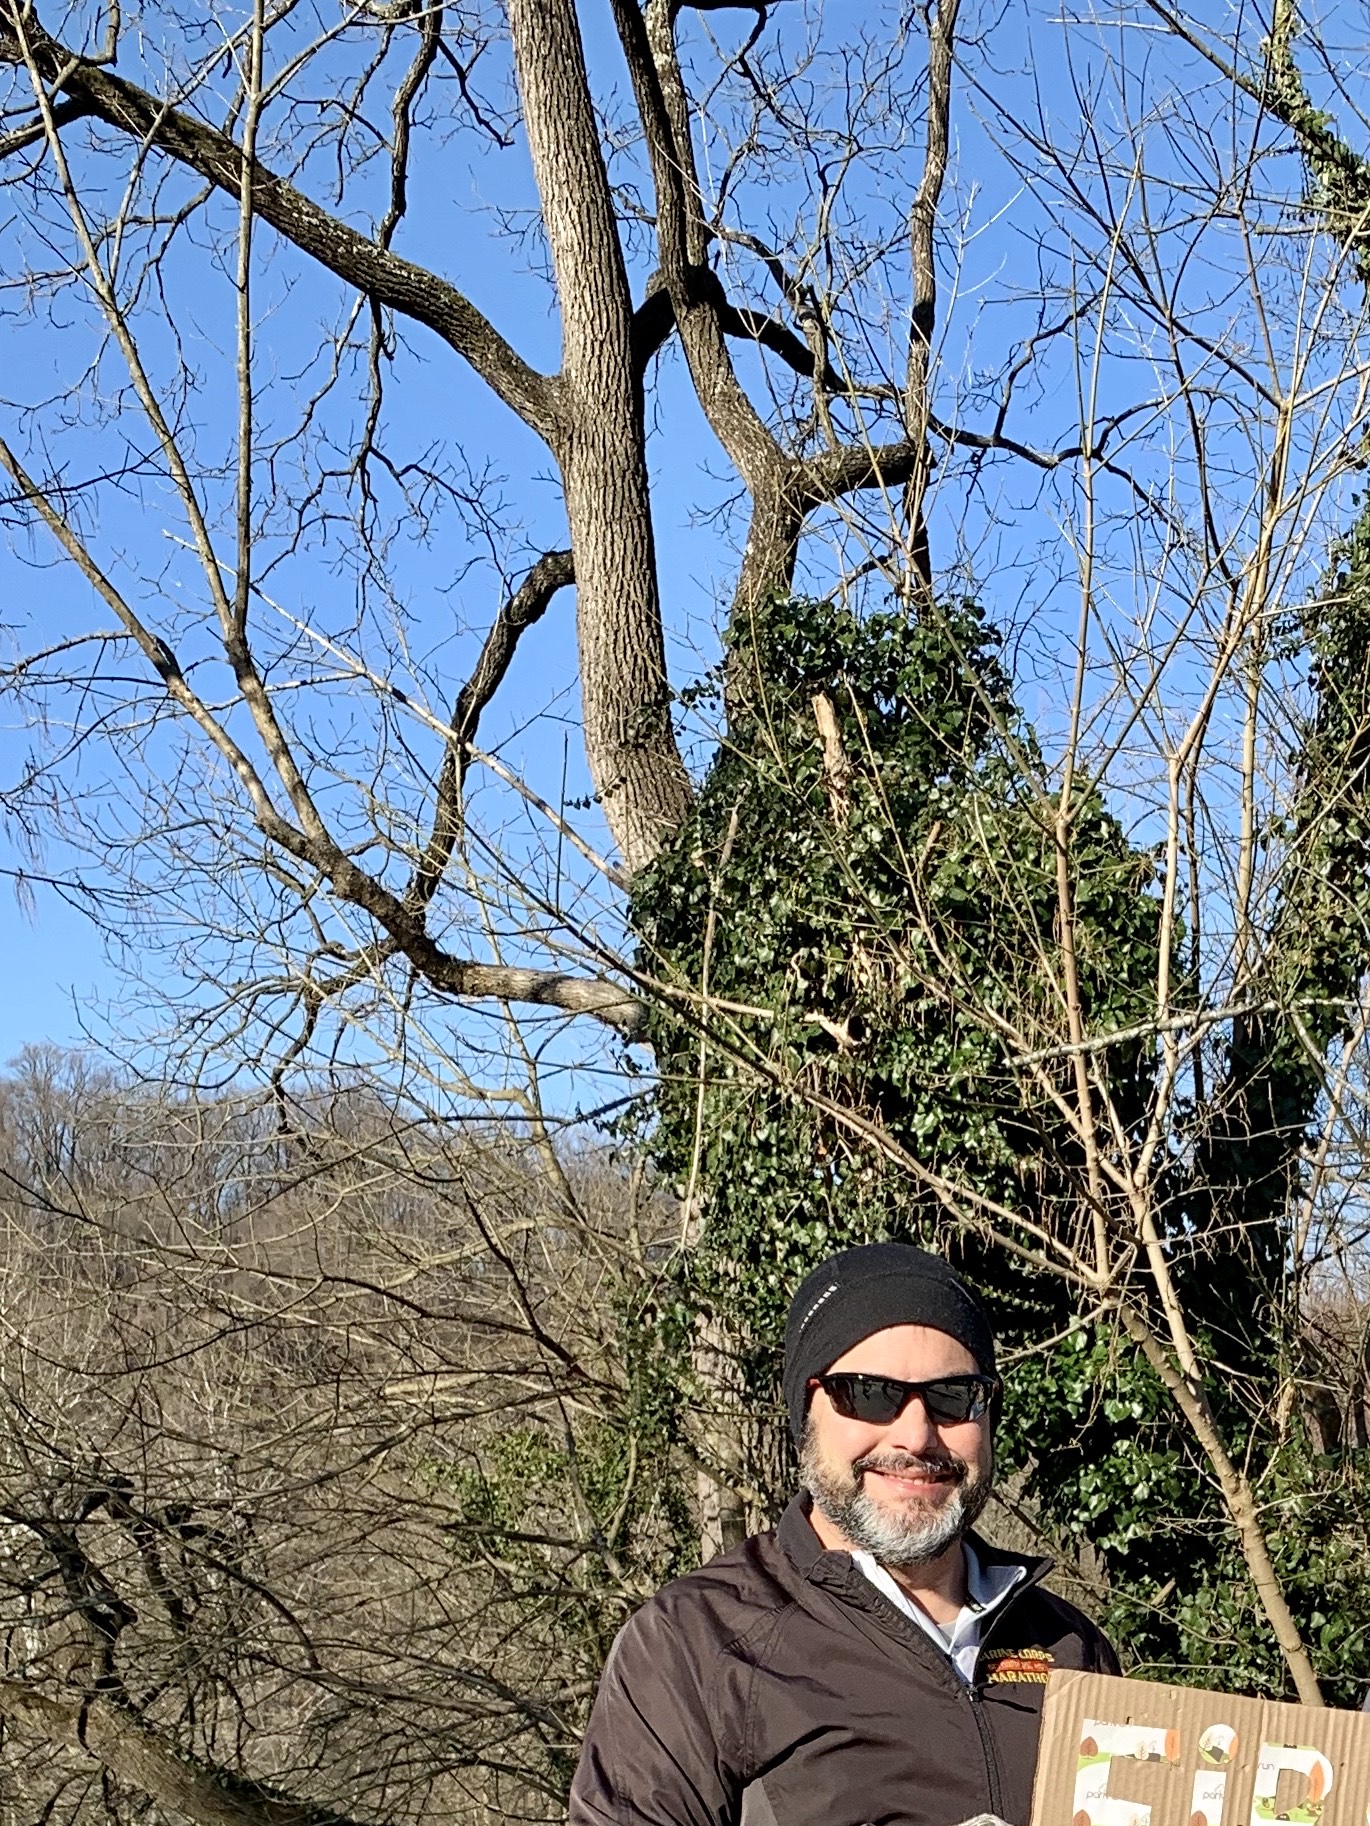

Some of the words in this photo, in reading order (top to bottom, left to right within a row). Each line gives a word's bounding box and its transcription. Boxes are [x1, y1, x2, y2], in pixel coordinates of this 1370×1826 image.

[981, 1648, 1018, 1661] ARINE
[1018, 1649, 1055, 1662] CORPS
[986, 1671, 1049, 1684] MARATHO
